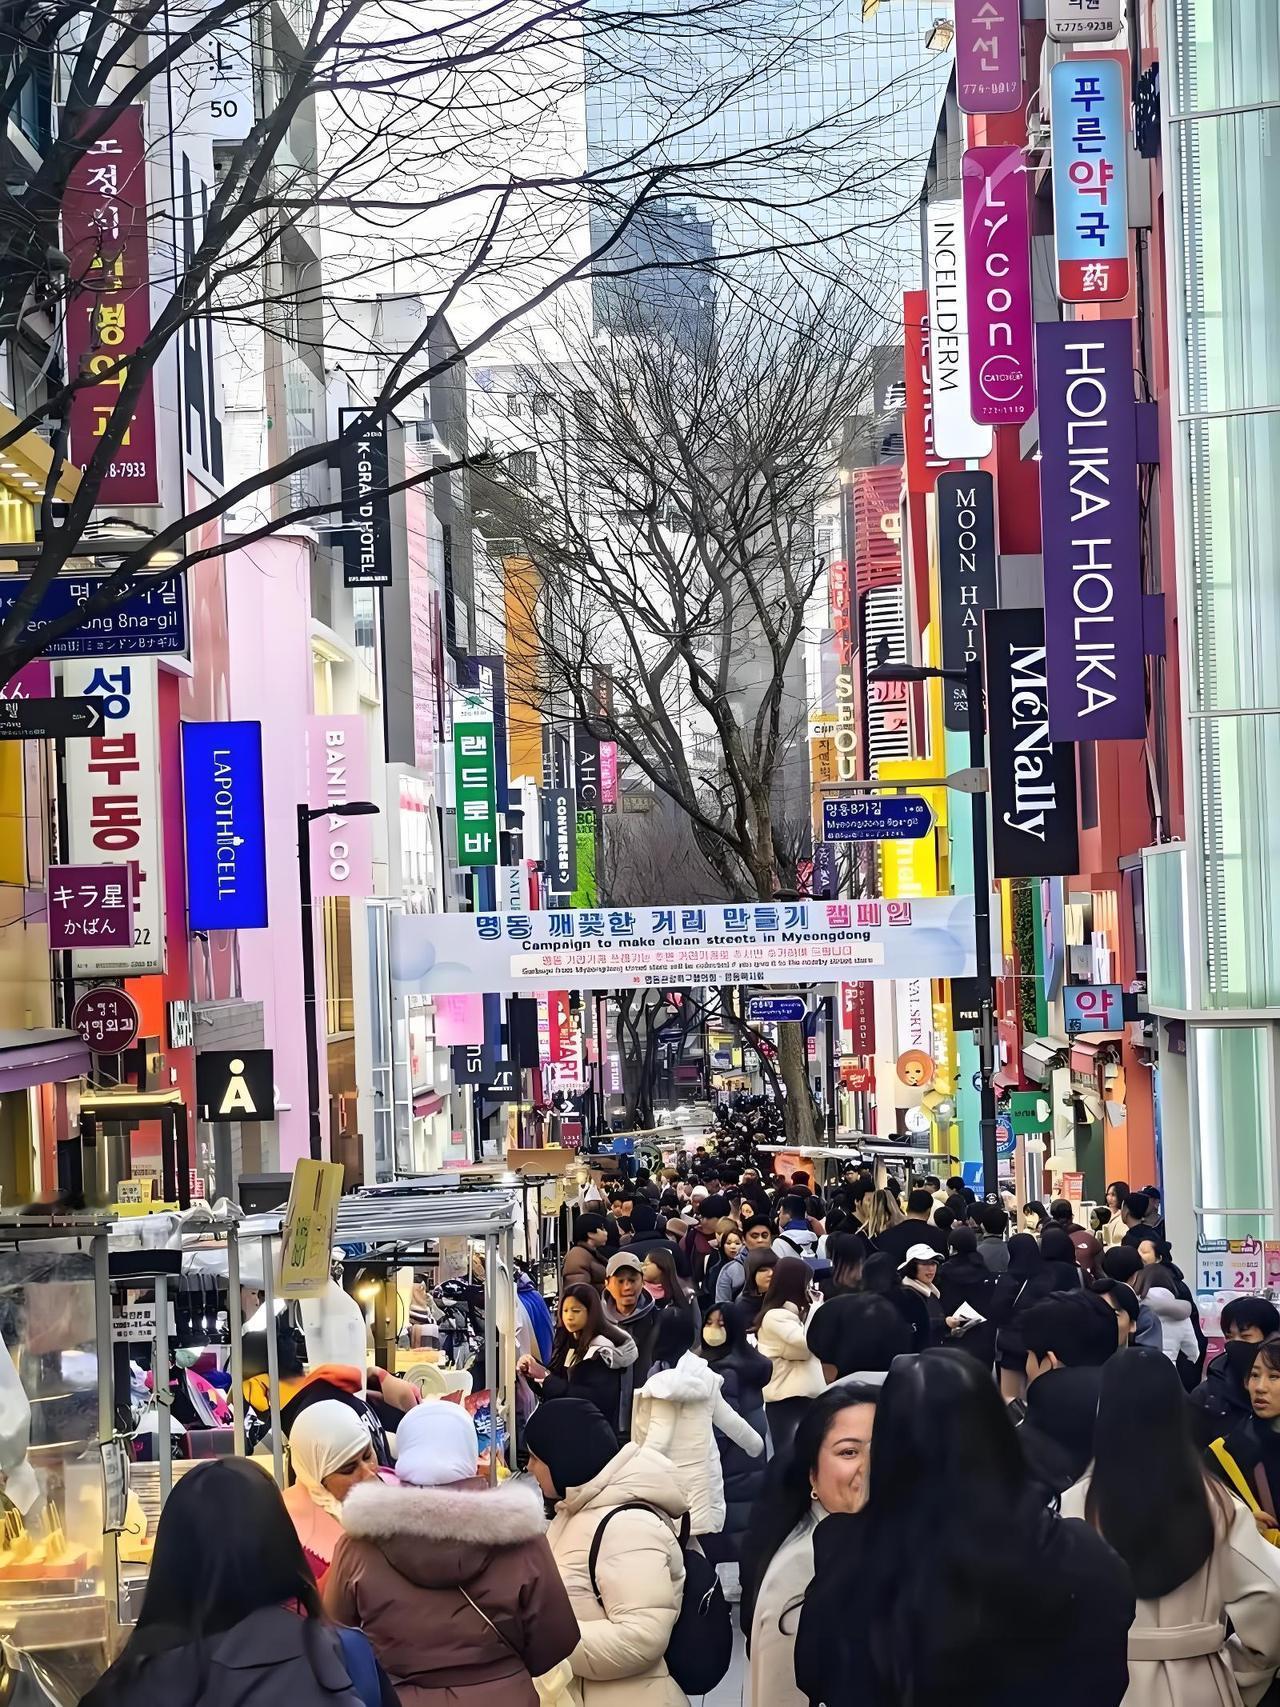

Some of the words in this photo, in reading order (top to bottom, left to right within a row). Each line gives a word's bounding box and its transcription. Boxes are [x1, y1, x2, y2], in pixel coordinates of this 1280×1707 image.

[971, 2, 1005, 71] 수선
[209, 100, 238, 118] 50
[1069, 77, 1114, 247] 푸른약국
[1080, 263, 1110, 292] 药
[934, 223, 959, 392] INCELLDERM
[1064, 342, 1111, 521] HOLIKA
[956, 488, 978, 573] MOON
[1071, 538, 1118, 717] HOLIKA
[53, 884, 125, 909] キラ星
[64, 917, 116, 935] かばん
[476, 914, 532, 940] 명동
[651, 909, 707, 934] 거리
[723, 905, 808, 932] 만들기
[826, 902, 912, 928] 캠페인
[522, 939, 591, 952] Campaign
[598, 939, 612, 948] to
[763, 932, 775, 943] in
[782, 931, 871, 943] Myeongdong
[1075, 989, 1114, 1029] 약
